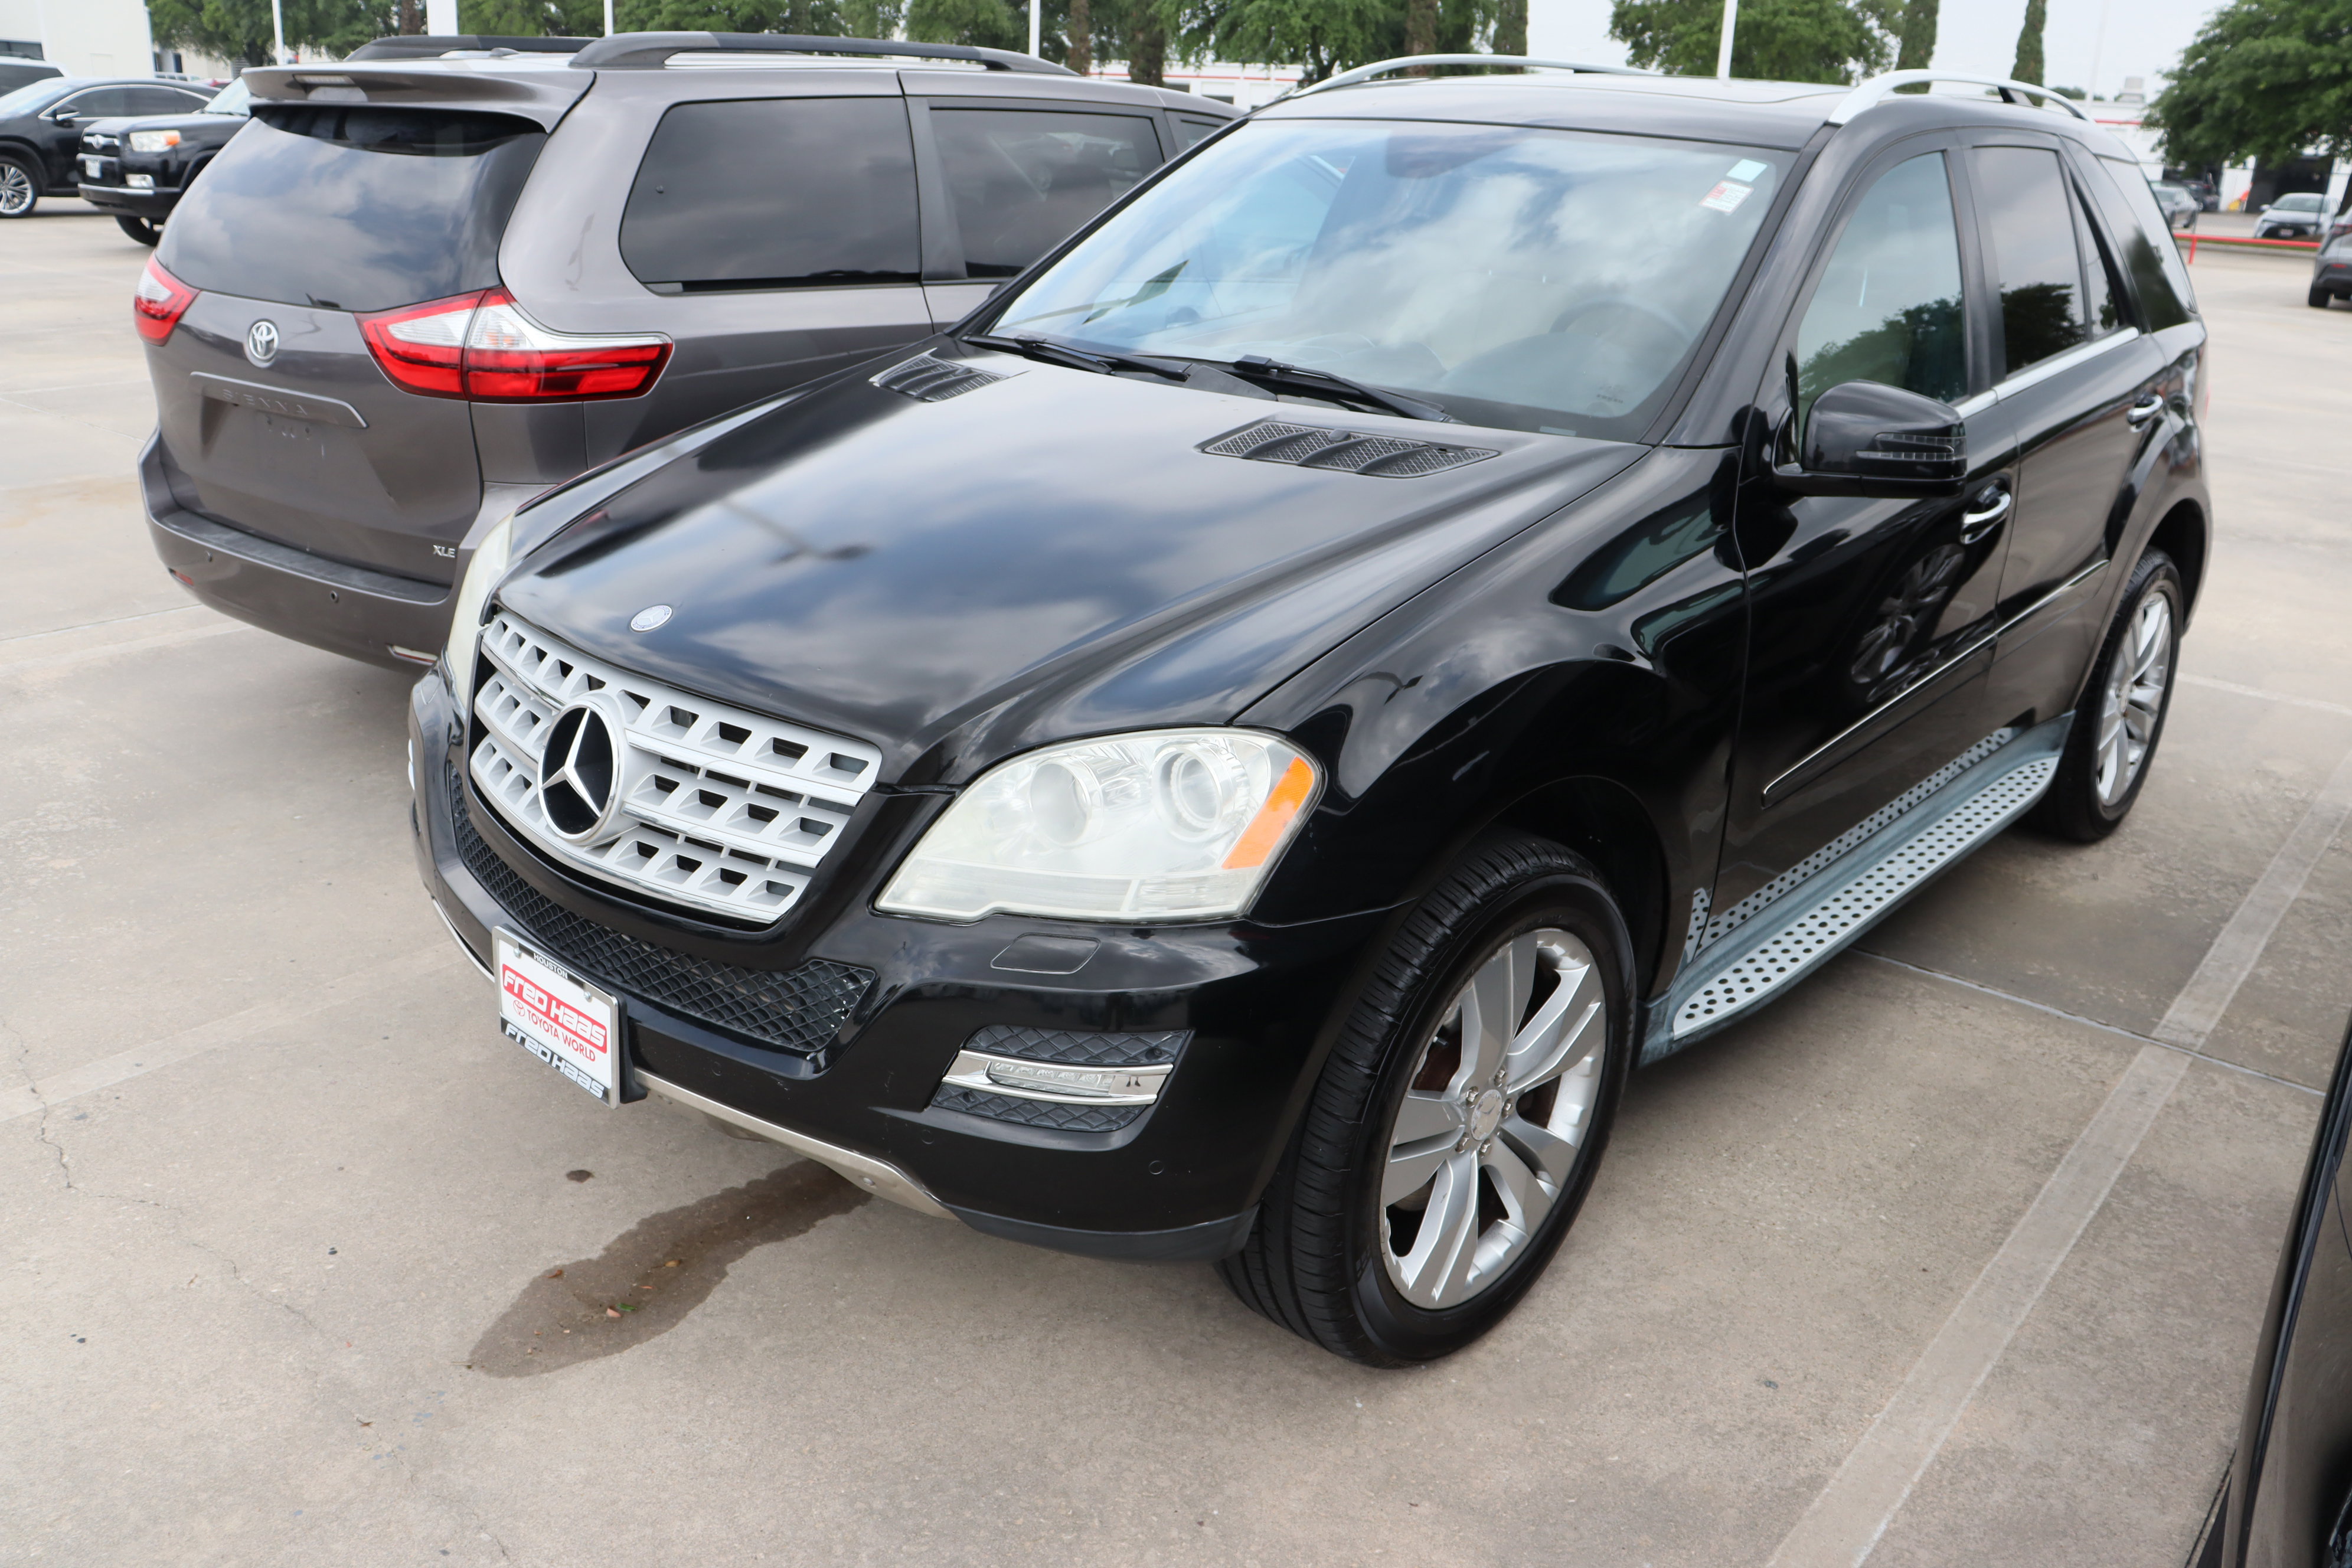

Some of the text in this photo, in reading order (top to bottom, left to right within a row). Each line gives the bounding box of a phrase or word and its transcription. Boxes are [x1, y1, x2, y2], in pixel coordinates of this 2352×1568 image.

[222, 388, 308, 416] SENNA
[433, 544, 456, 558] XLE
[533, 952, 569, 979] HOUSTON
[527, 1008, 596, 1062] TOYOTA WORLD
